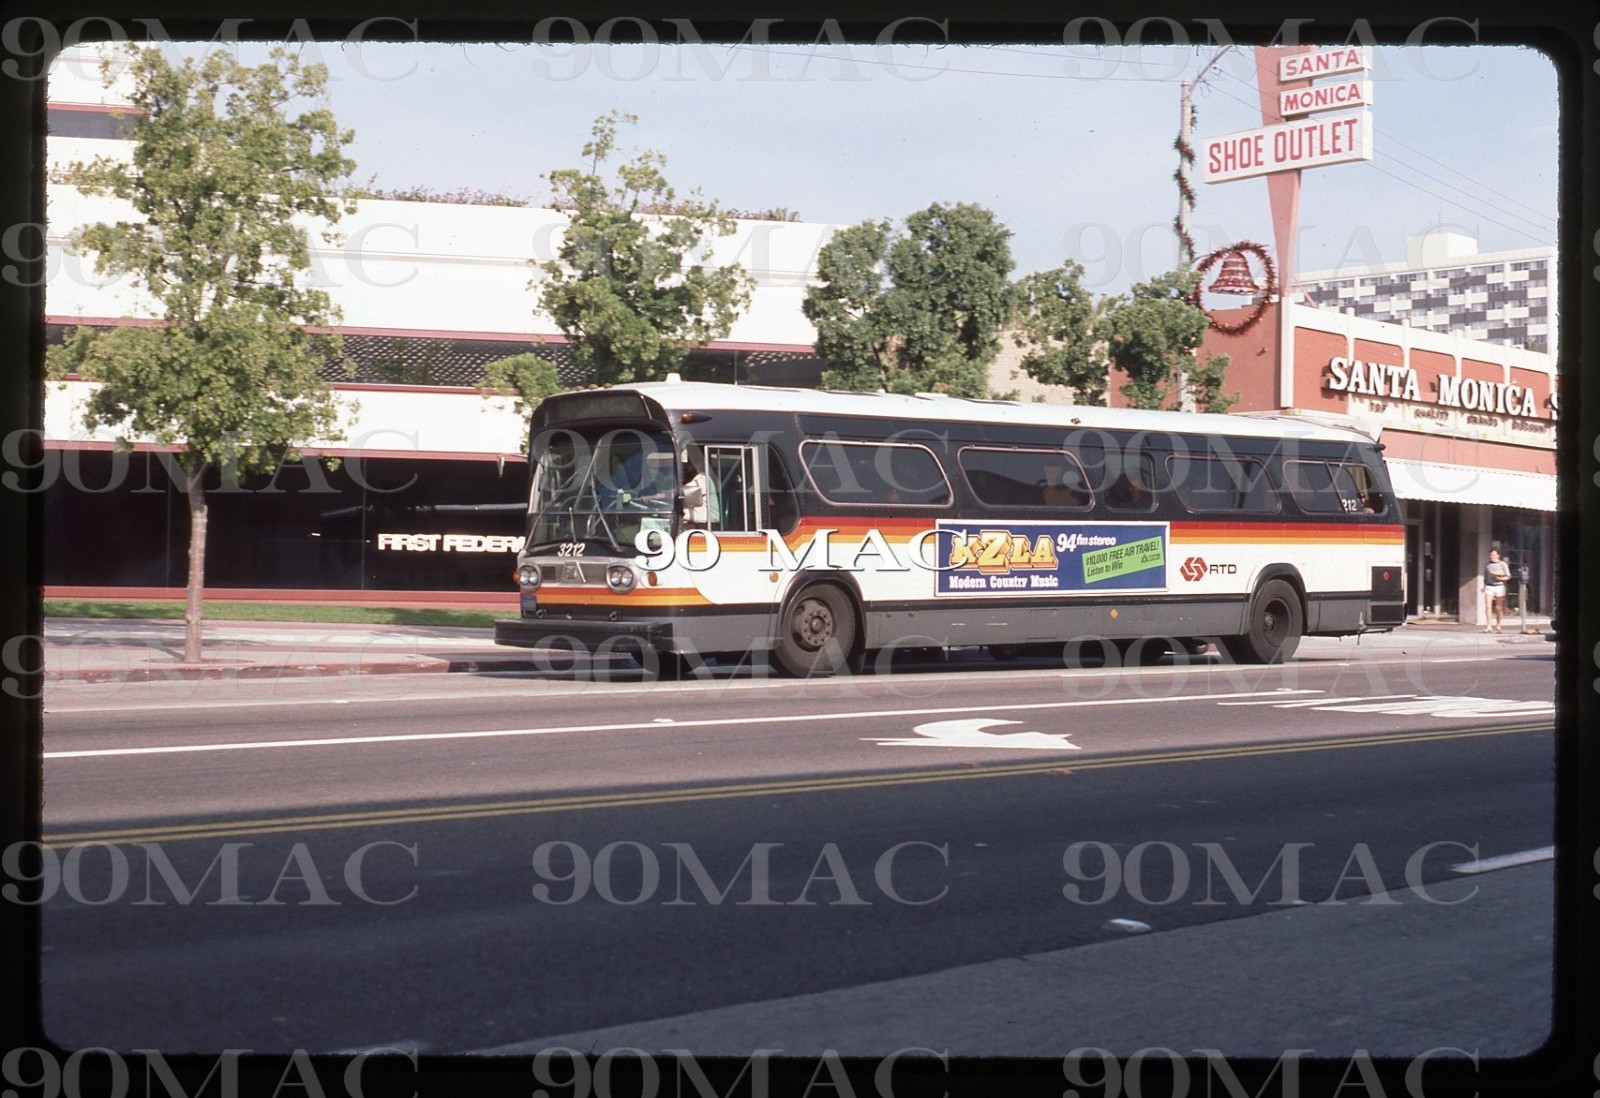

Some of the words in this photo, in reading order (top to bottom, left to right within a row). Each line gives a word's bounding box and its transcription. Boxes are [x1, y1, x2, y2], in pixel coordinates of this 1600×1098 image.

[1286, 49, 1360, 77] SANTA
[1284, 83, 1361, 111] MONICA
[1209, 134, 1264, 174] SHOE
[1274, 118, 1358, 163] OUTLET
[1329, 357, 1421, 401] SANTA
[1438, 374, 1538, 418] MONICA
[377, 533, 441, 551] FIRST
[557, 542, 586, 557] 3212
[949, 529, 1059, 575] KZLA
[1056, 533, 1077, 552] 94
[1076, 534, 1089, 546] fm
[1089, 535, 1116, 546] stereo
[1085, 552, 1108, 567] $10,000
[1109, 548, 1124, 561] FREE
[1124, 546, 1135, 558] AIR
[1136, 541, 1160, 555] TRAVEL!
[1087, 564, 1104, 577] Listen
[1105, 563, 1111, 573] to
[1111, 560, 1123, 571] Win
[1209, 564, 1237, 575] RTD
[949, 576, 987, 589] Modern
[990, 575, 1027, 589] Country
[1030, 574, 1058, 588] Music
